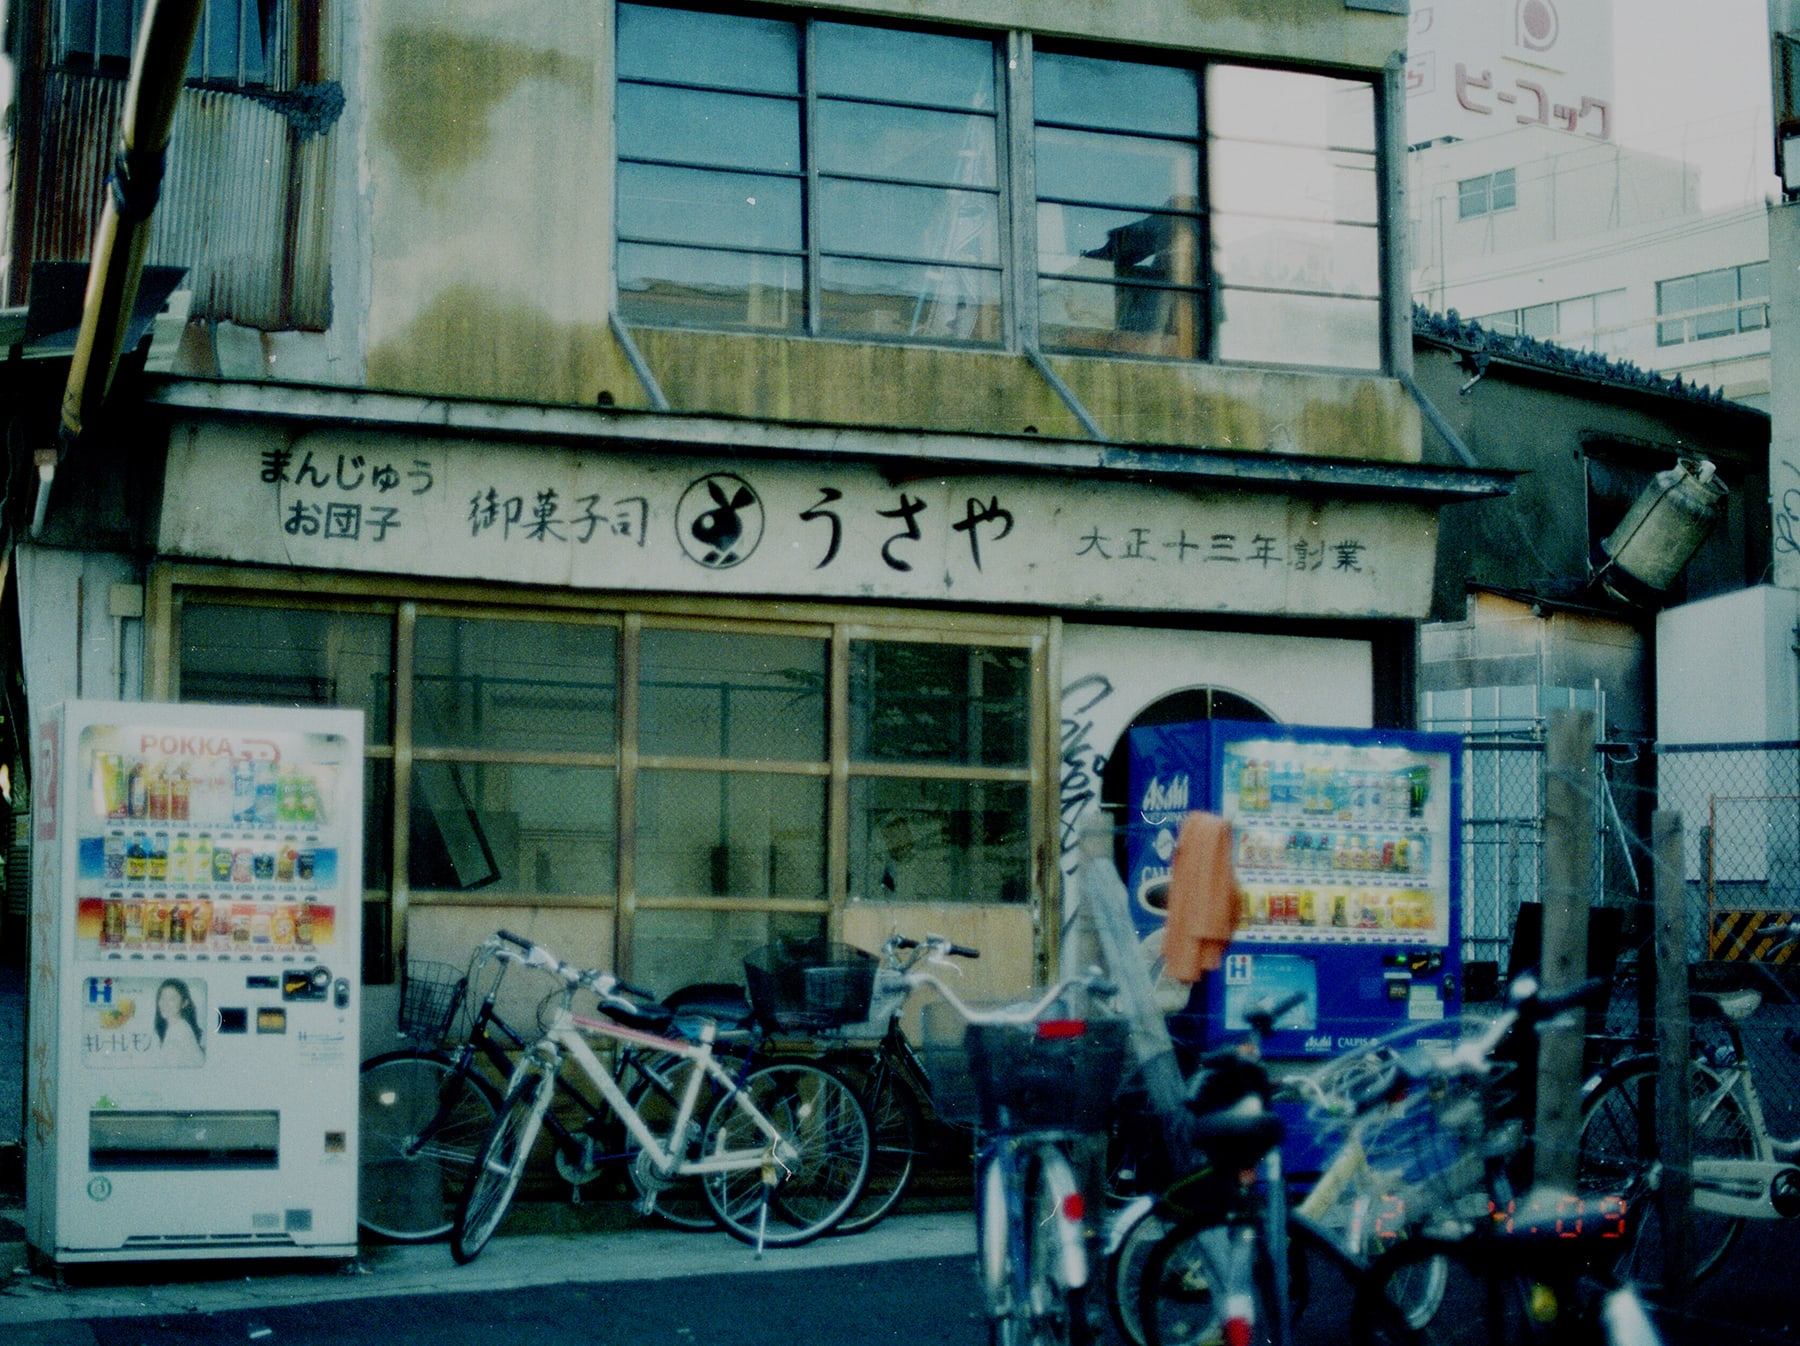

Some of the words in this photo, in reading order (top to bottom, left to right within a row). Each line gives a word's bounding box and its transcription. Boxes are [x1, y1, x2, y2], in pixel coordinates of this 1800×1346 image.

[1455, 62, 1612, 141] ピーコック
[260, 449, 434, 496] まんじゅう
[283, 502, 402, 543] お団子
[469, 486, 649, 548] 御菓子司
[799, 486, 1015, 573] うさや
[1076, 525, 1368, 574] 大正十三年創業
[140, 734, 234, 758] POKKA
